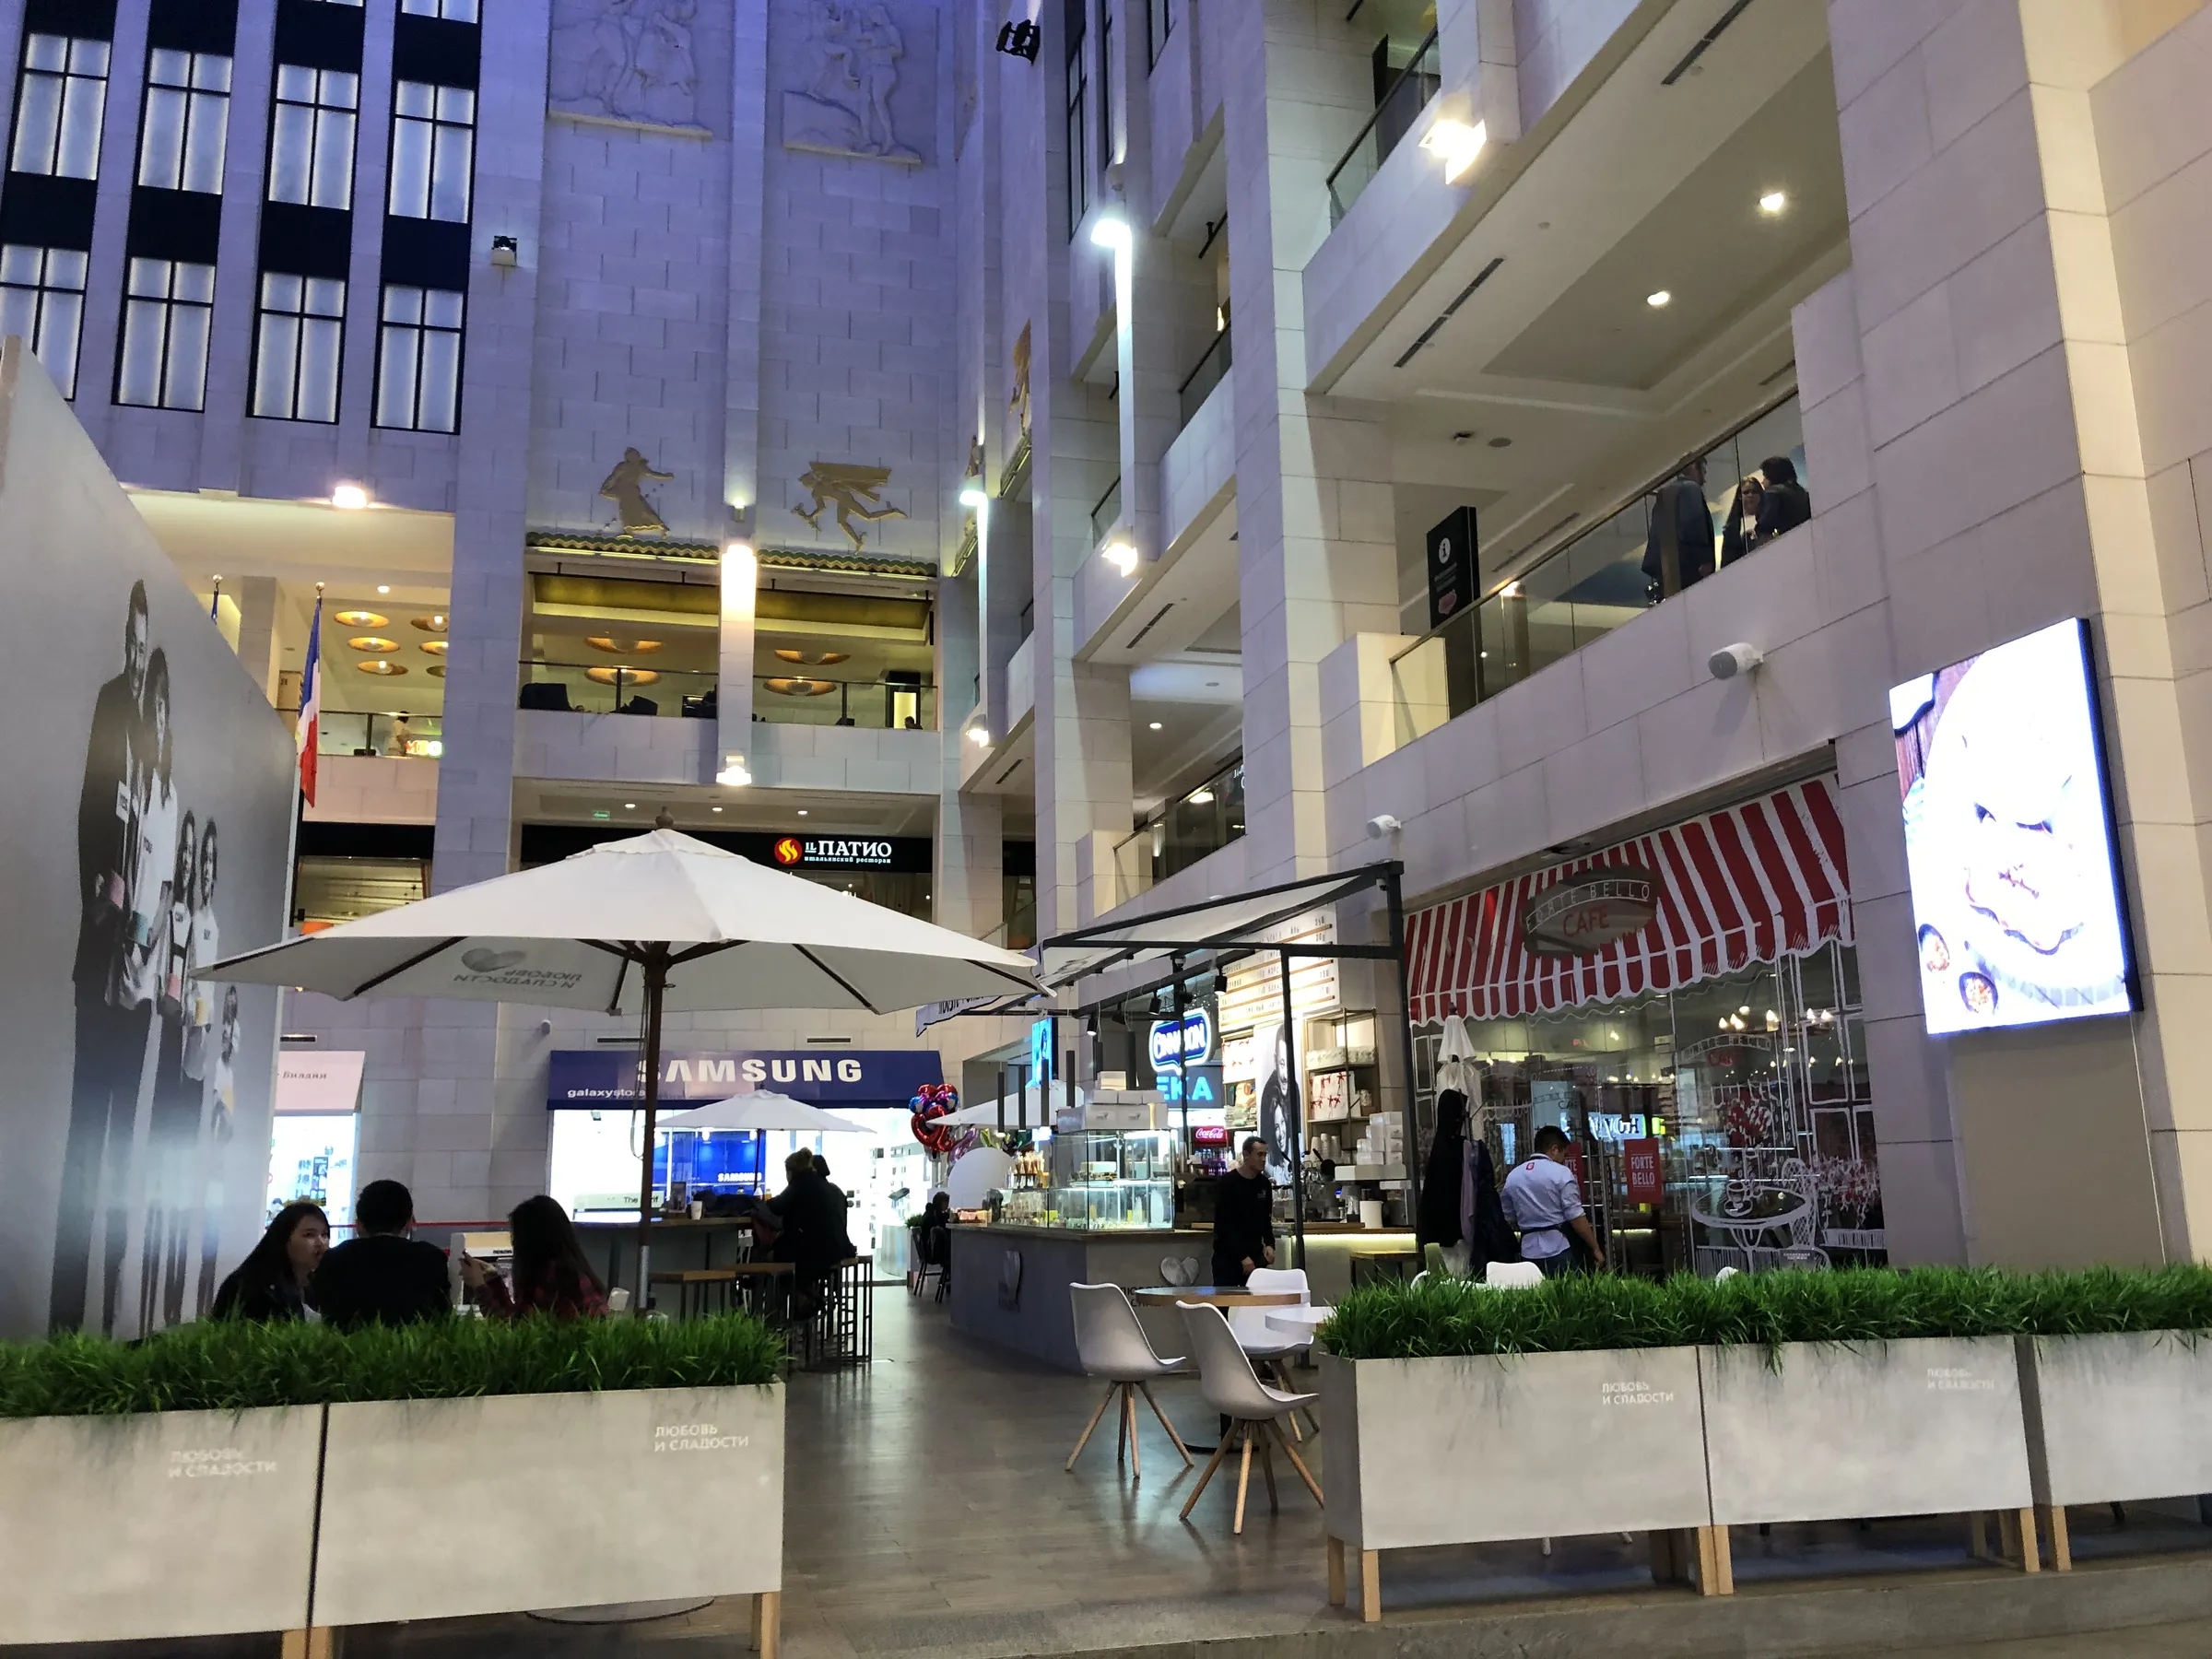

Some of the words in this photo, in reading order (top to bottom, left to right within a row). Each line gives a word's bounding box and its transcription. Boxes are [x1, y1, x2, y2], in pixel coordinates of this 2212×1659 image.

[818, 841, 892, 857] ПАТИО
[1525, 889, 1578, 933] FORTE
[1590, 882, 1650, 900] BELLO
[1563, 905, 1609, 937] CAFE
[1630, 1156, 1654, 1170] FORTE
[1632, 1172, 1655, 1185] BELLO
[1602, 1382, 1650, 1394] ЛЮБОВЬ
[1603, 1395, 1611, 1406] И
[1614, 1392, 1675, 1405] СЛАДОСТИ
[655, 1424, 718, 1438] ЛЮБОВЬ
[654, 1441, 665, 1453] И
[669, 1436, 749, 1452] СЛАДОСТИ
